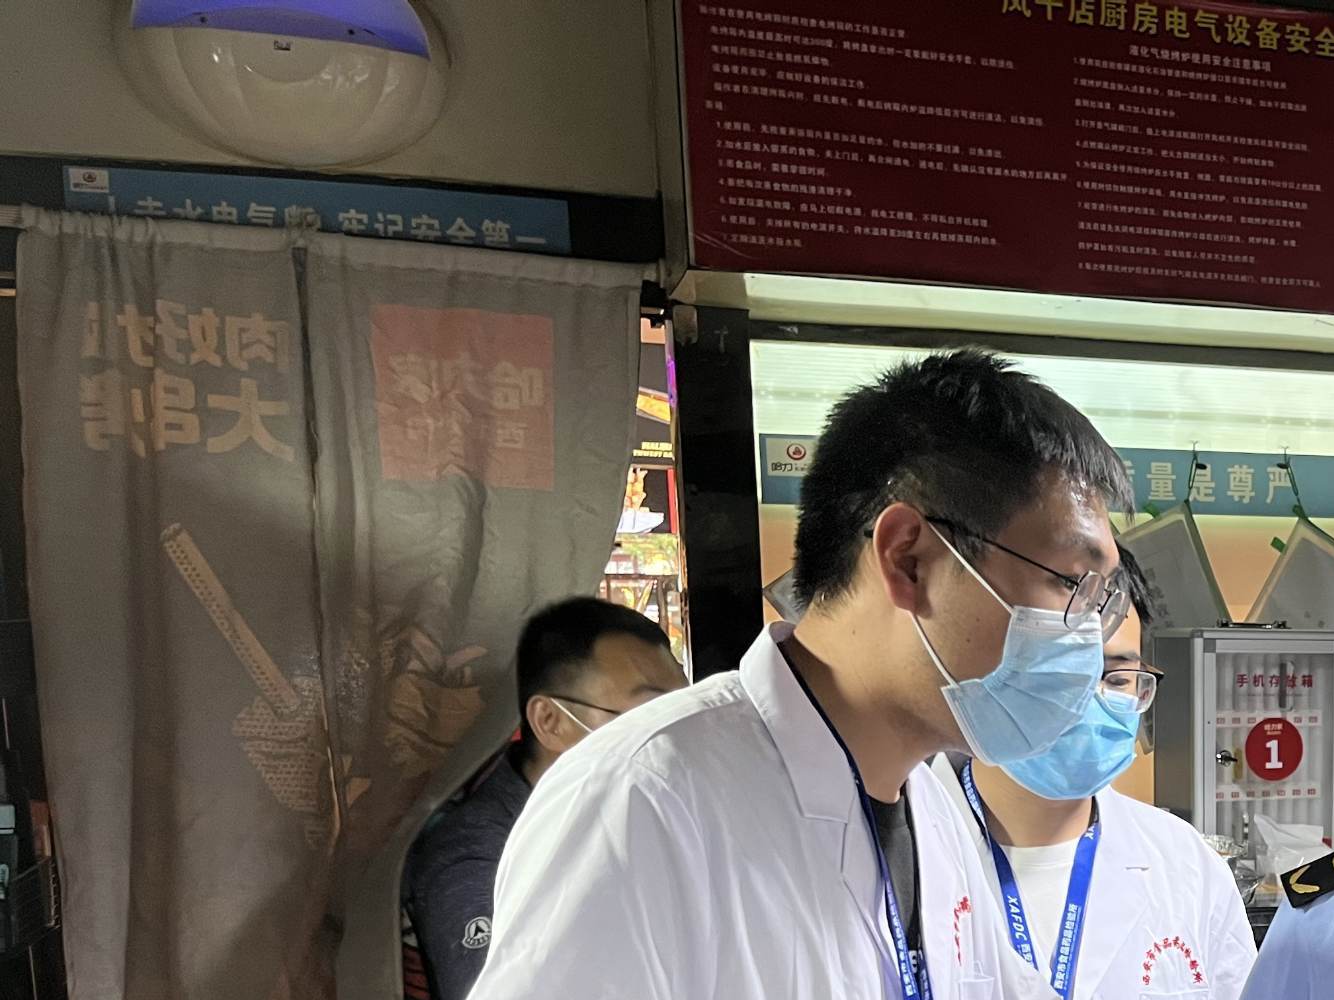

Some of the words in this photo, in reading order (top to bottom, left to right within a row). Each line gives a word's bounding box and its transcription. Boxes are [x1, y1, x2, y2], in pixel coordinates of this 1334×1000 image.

[1236, 673, 1314, 689] 手机存放箱
[1265, 739, 1284, 770] 1
[1007, 894, 1028, 942] XAFDC
